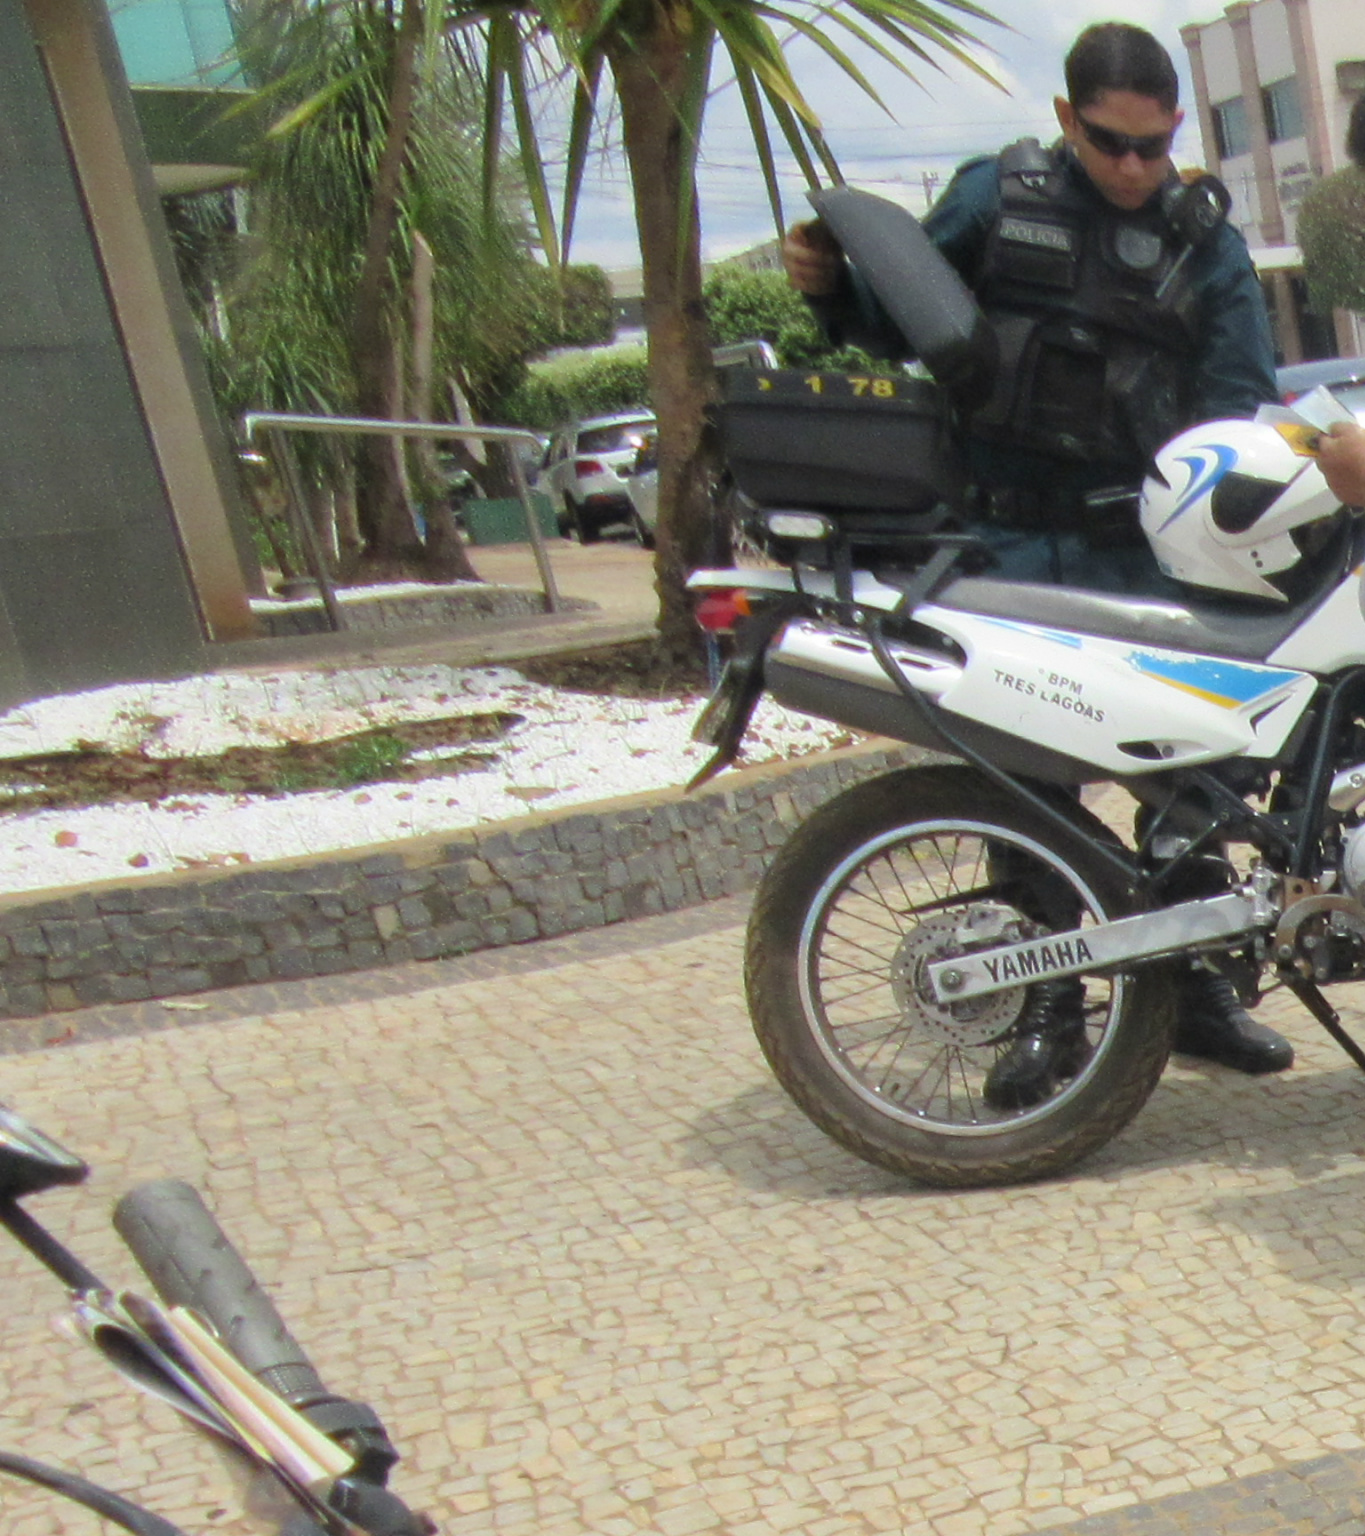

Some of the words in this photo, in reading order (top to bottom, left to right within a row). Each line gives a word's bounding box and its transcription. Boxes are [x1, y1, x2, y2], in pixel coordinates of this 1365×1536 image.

[993, 669, 1037, 696] TRES
[1040, 690, 1105, 722] LAGOAS
[1047, 672, 1083, 695] BPM
[982, 937, 1093, 983] YAMAHA
